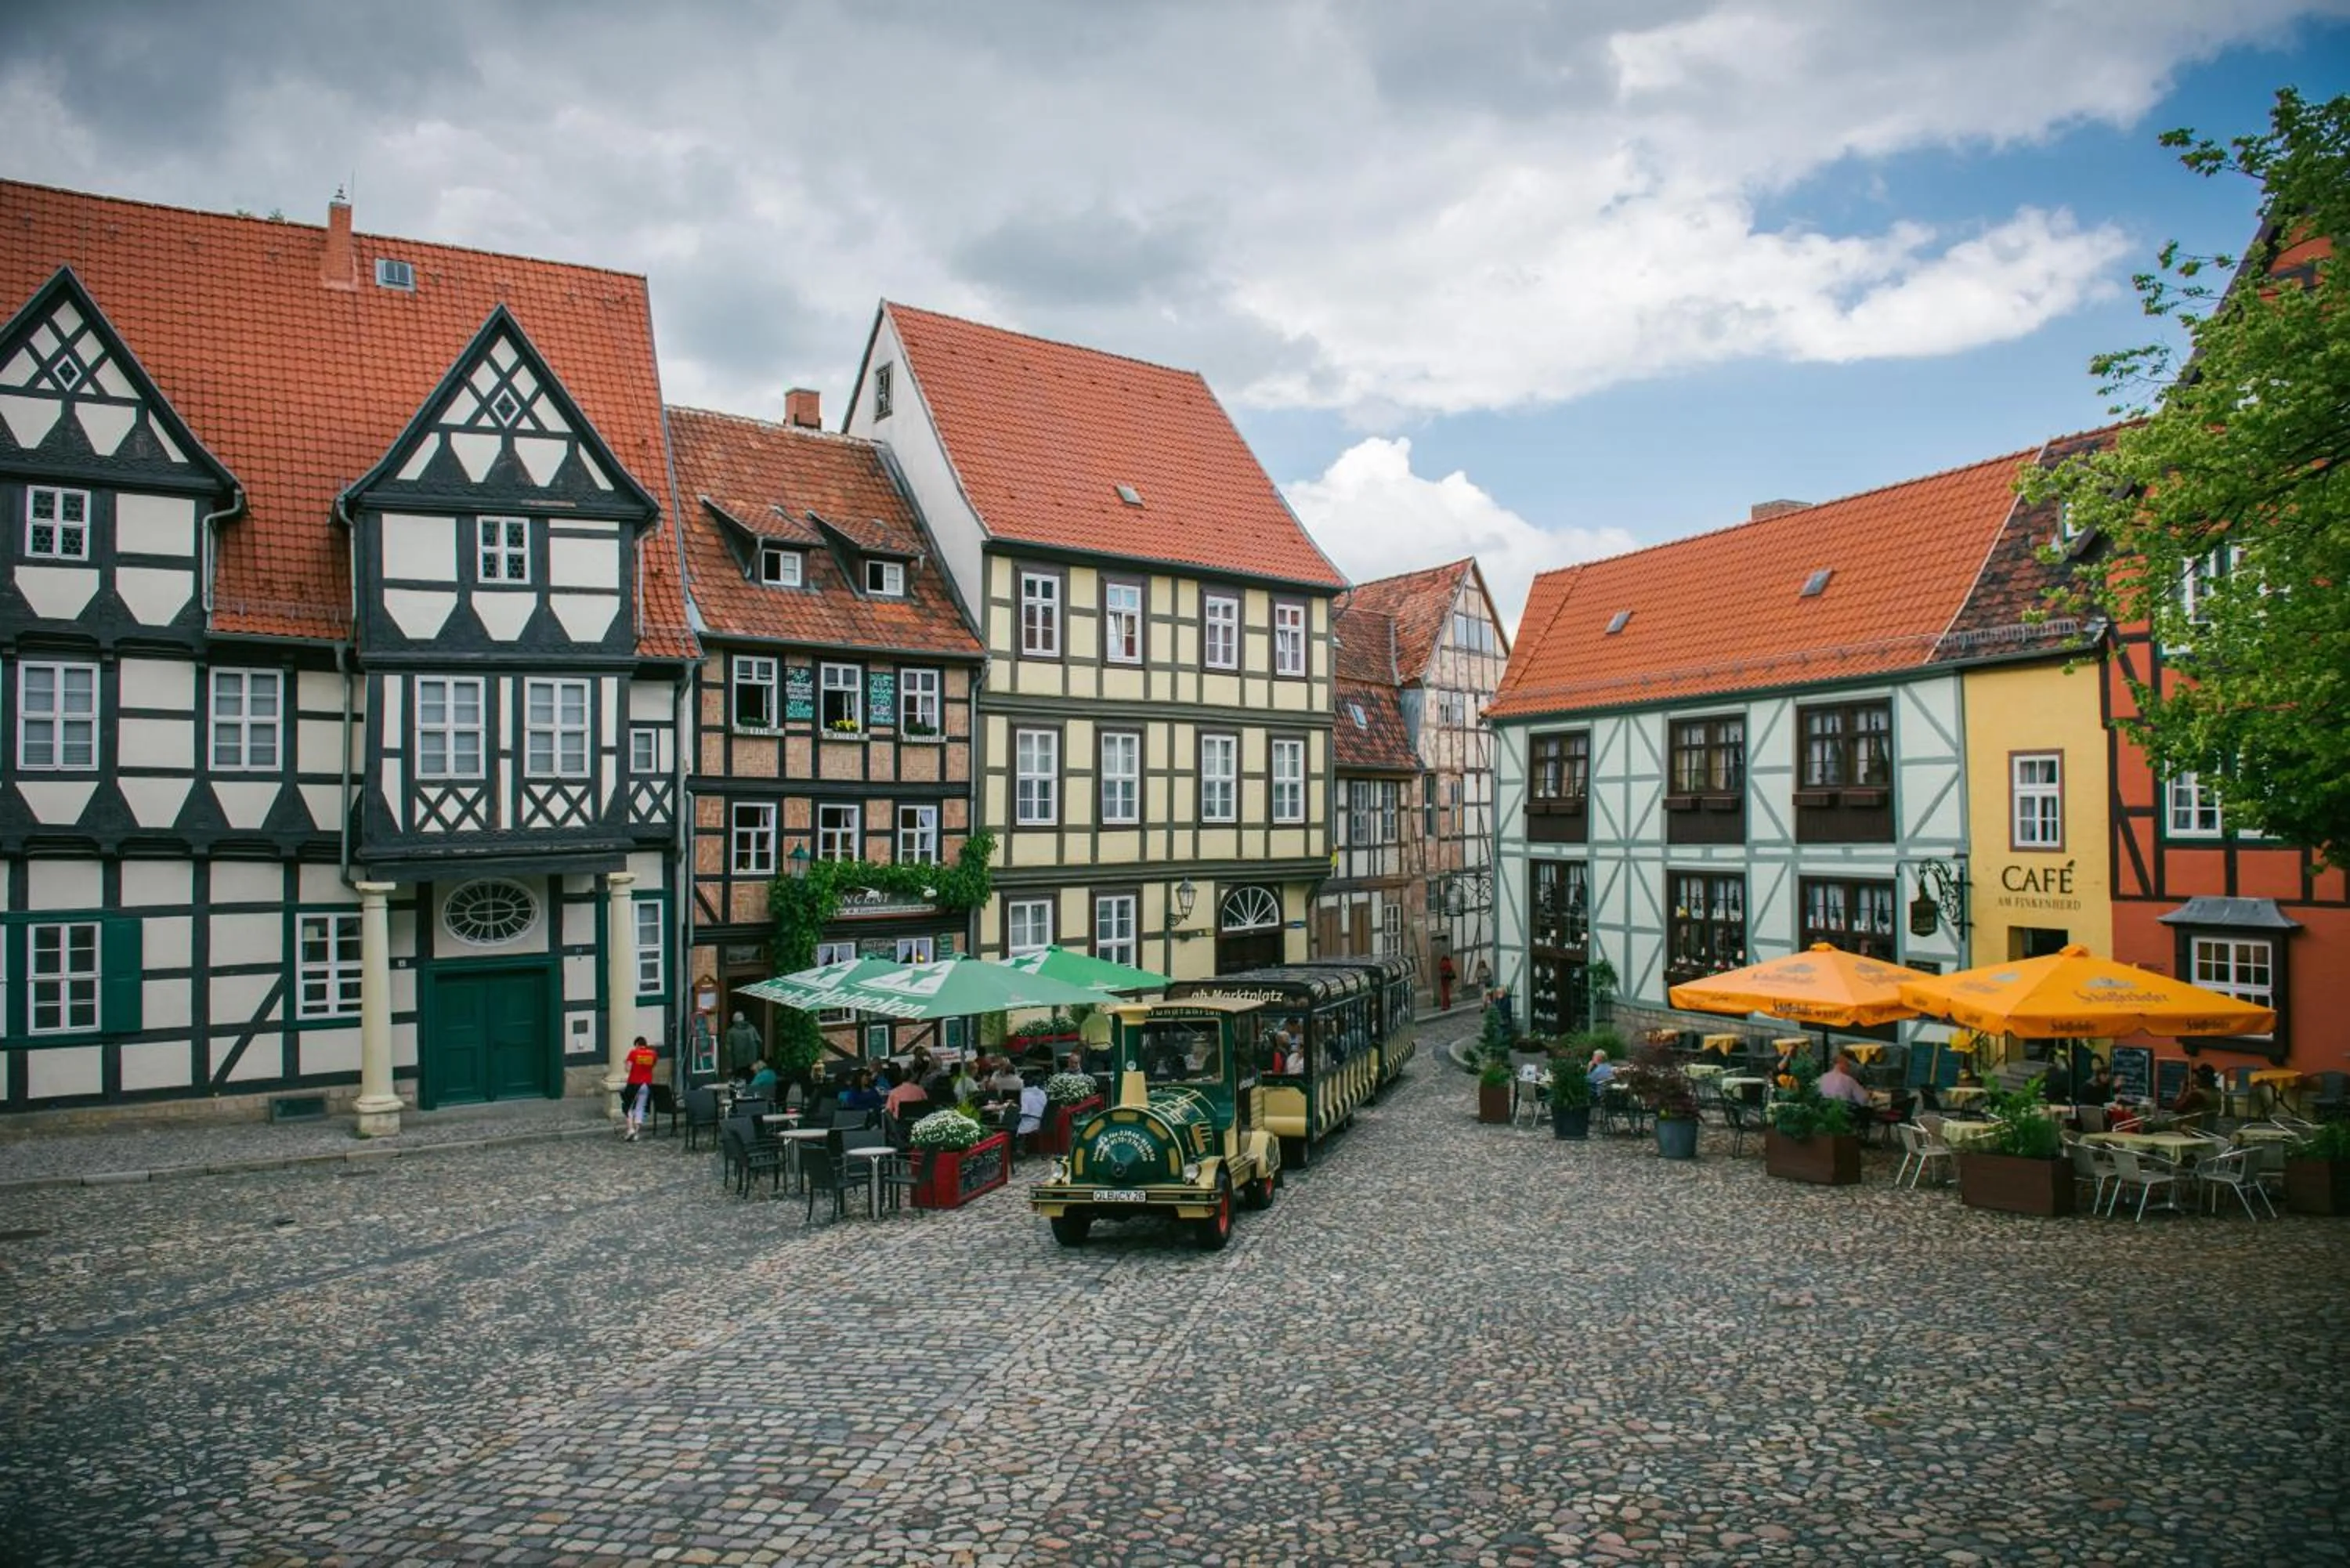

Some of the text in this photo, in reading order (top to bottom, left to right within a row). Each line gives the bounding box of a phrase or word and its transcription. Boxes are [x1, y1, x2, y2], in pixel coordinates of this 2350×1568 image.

[2001, 860, 2075, 894] CAFÉ
[1998, 897, 2081, 910] AM FINKENHERD
[1213, 988, 1285, 1002] Marktplatz
